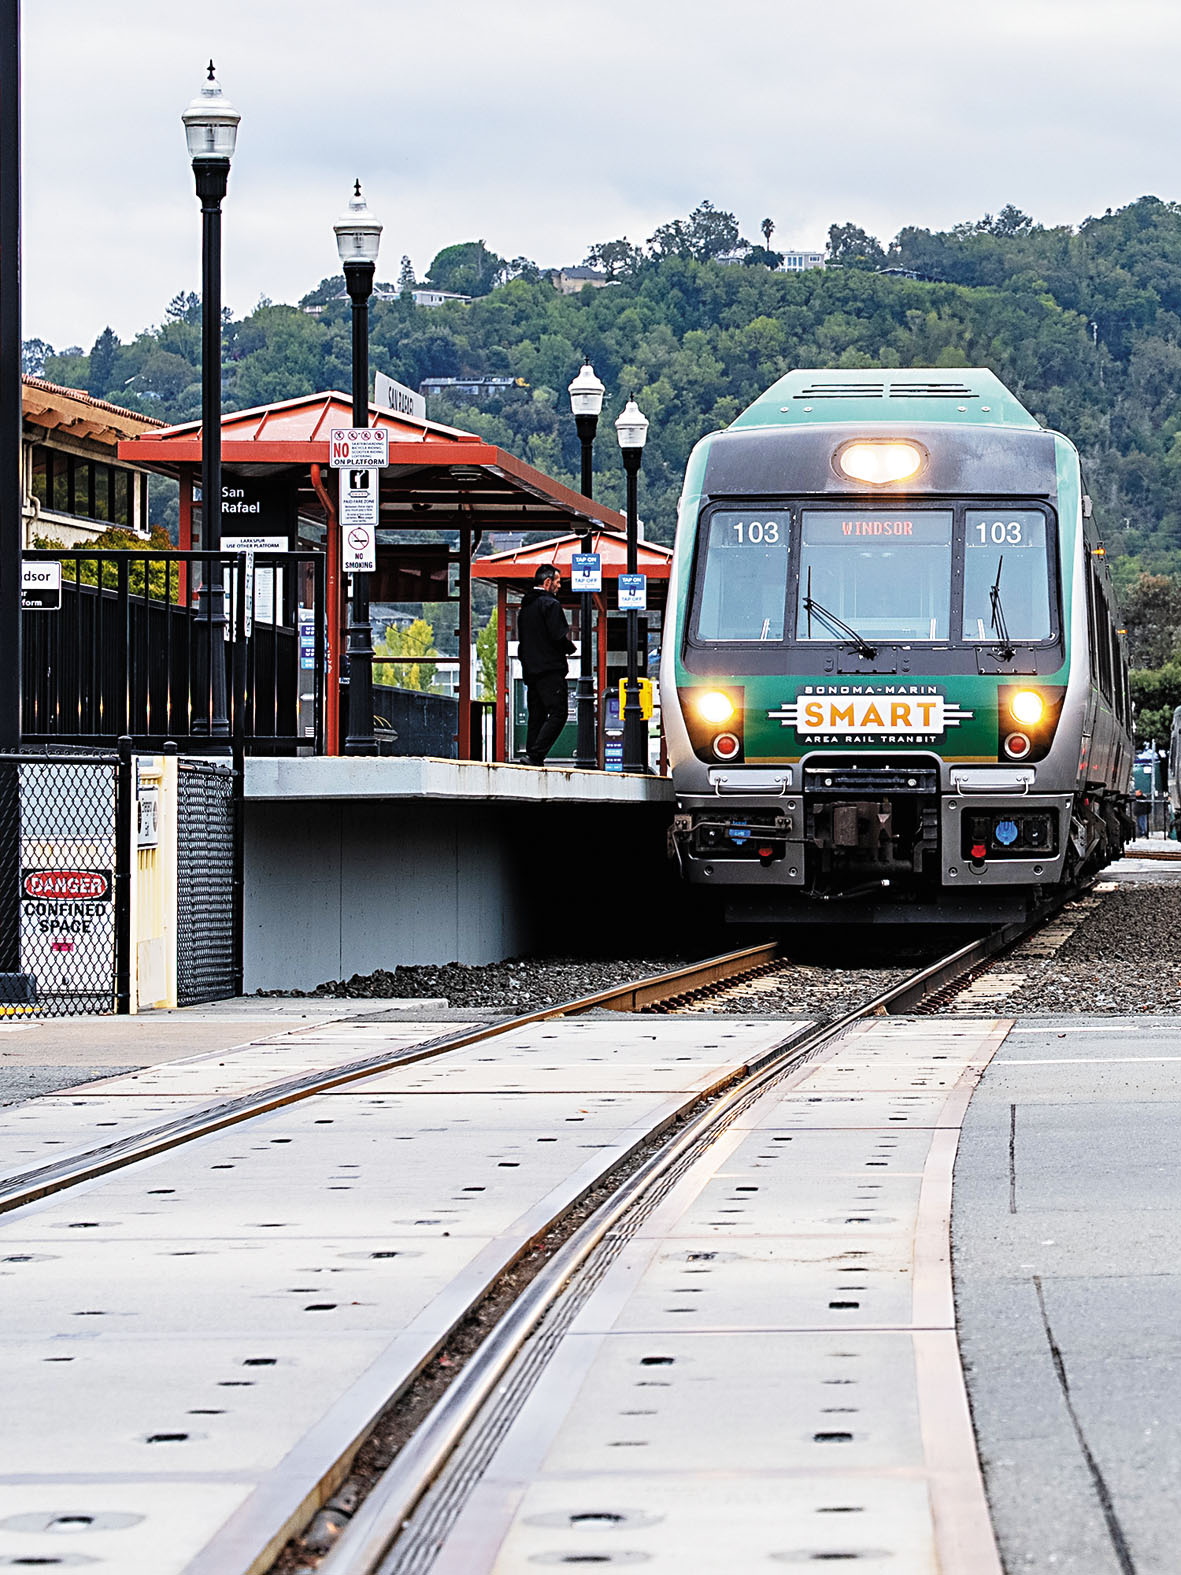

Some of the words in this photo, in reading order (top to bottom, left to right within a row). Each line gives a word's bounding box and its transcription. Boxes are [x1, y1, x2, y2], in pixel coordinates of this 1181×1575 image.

[334, 443, 349, 458] NO
[221, 486, 244, 497] San
[221, 501, 260, 513] Rafael
[733, 522, 779, 543] 103
[842, 522, 913, 535] WINDSOR
[976, 522, 1022, 543] 103
[805, 702, 936, 727] SMART
[31, 878, 102, 893] DANGER
[24, 903, 106, 916] CONFINED
[40, 920, 92, 933] SPACE
